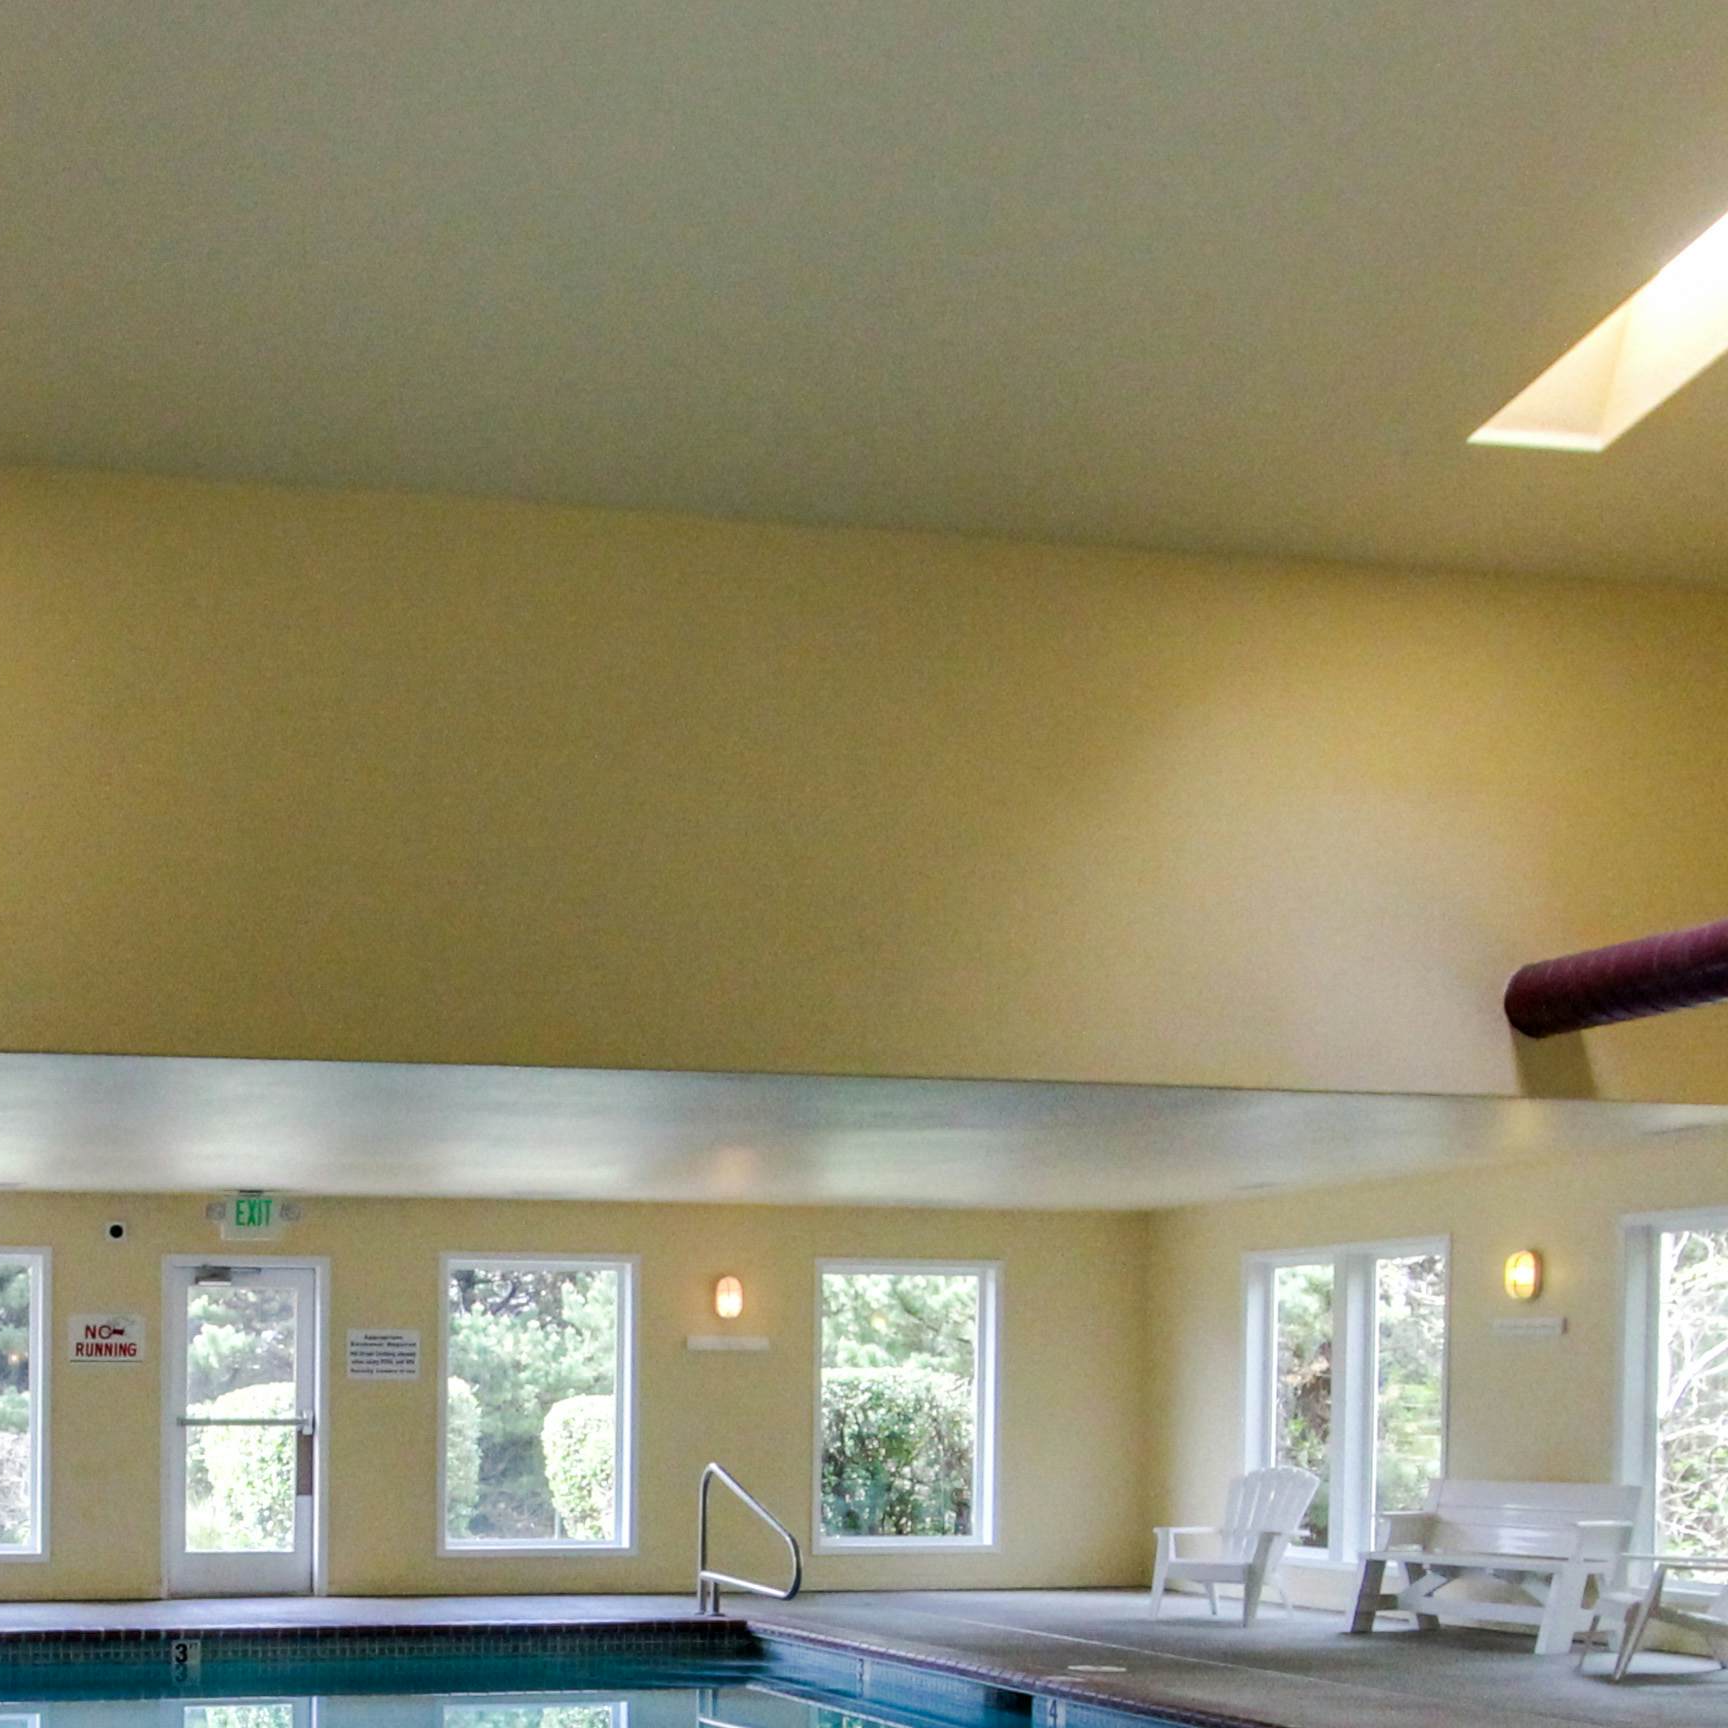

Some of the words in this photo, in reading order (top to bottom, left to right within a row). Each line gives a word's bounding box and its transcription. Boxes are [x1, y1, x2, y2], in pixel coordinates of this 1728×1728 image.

[235, 1199, 272, 1227] EXIT
[85, 1325, 112, 1339] NO
[76, 1342, 137, 1357] RUNNING
[175, 1643, 188, 1663] 3
